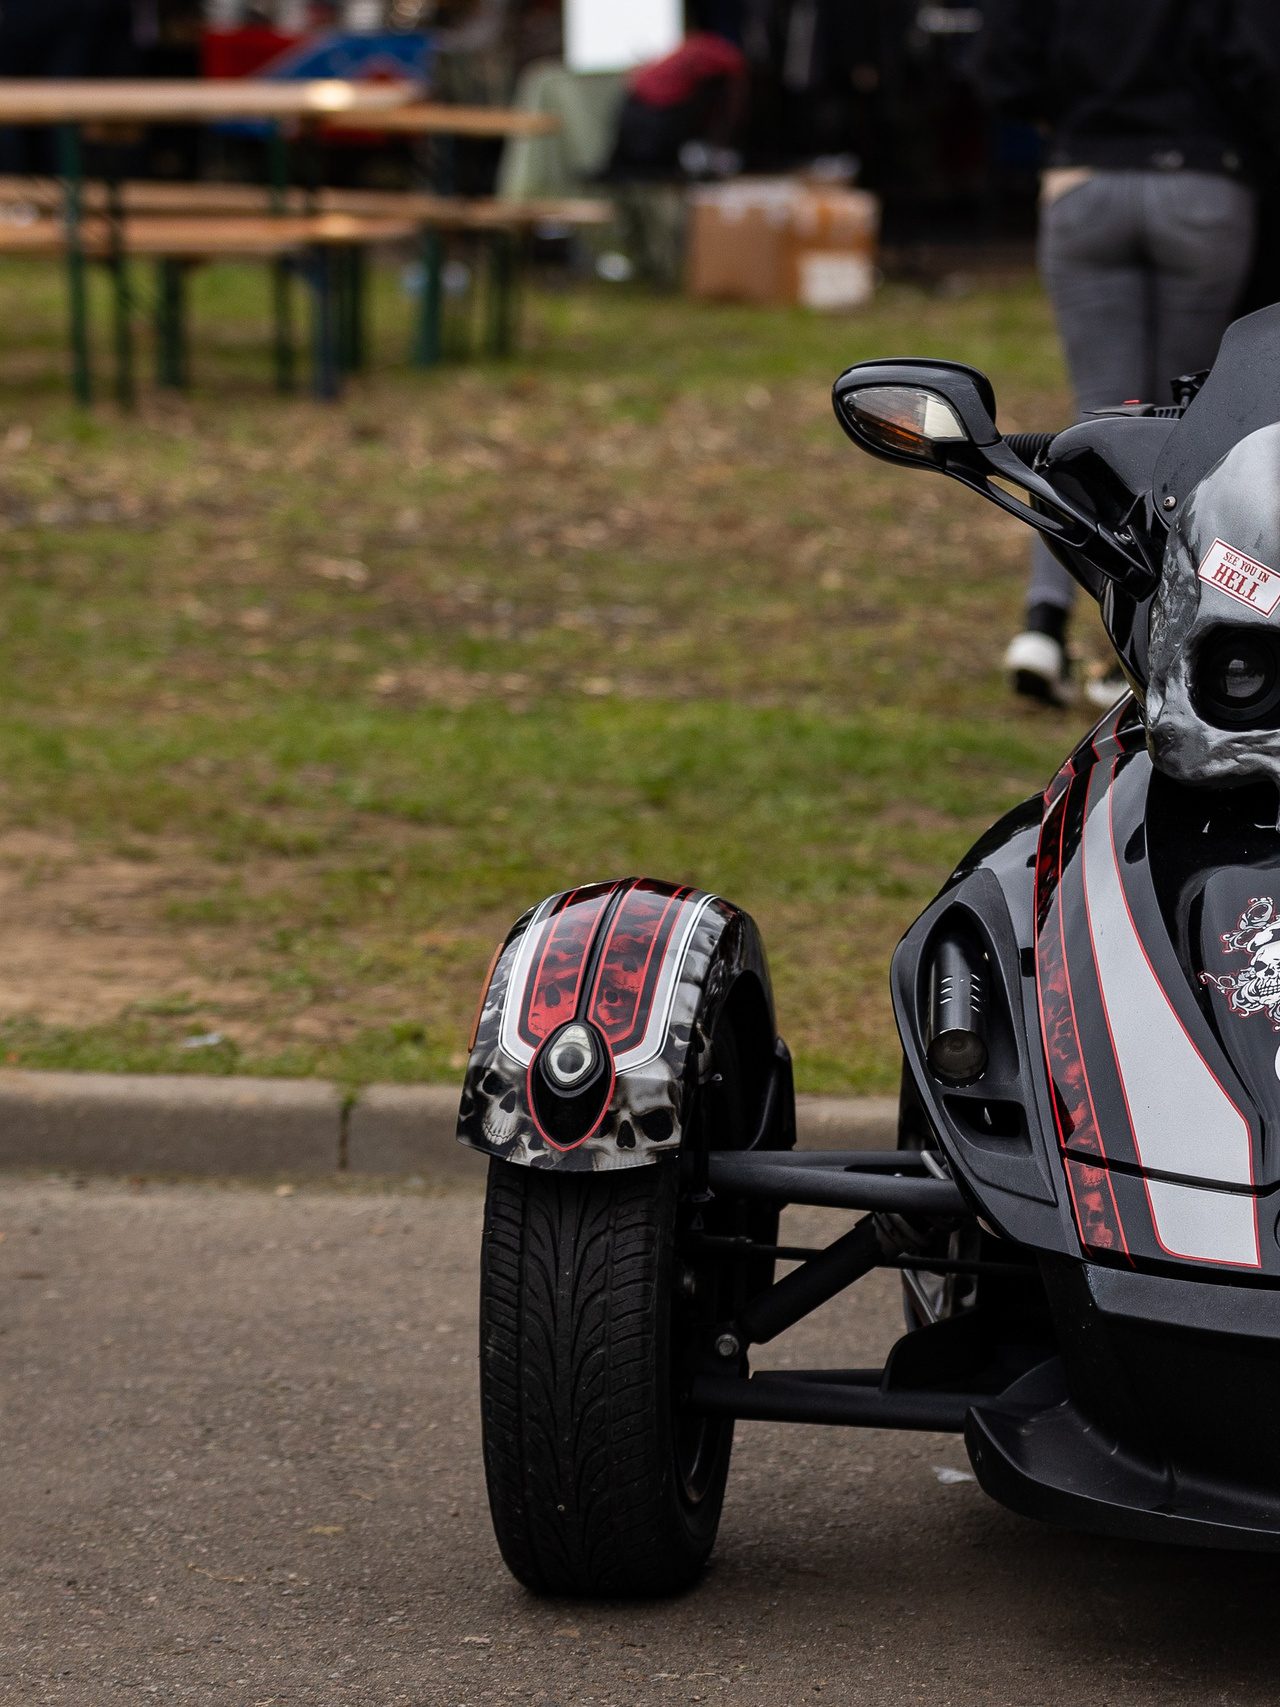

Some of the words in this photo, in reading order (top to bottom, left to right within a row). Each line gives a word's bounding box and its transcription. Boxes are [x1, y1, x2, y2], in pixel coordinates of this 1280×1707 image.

[1211, 562, 1260, 604] HELL
[1223, 551, 1241, 566] SEE
[1240, 559, 1259, 576] YOU
[1257, 570, 1271, 584] IN
